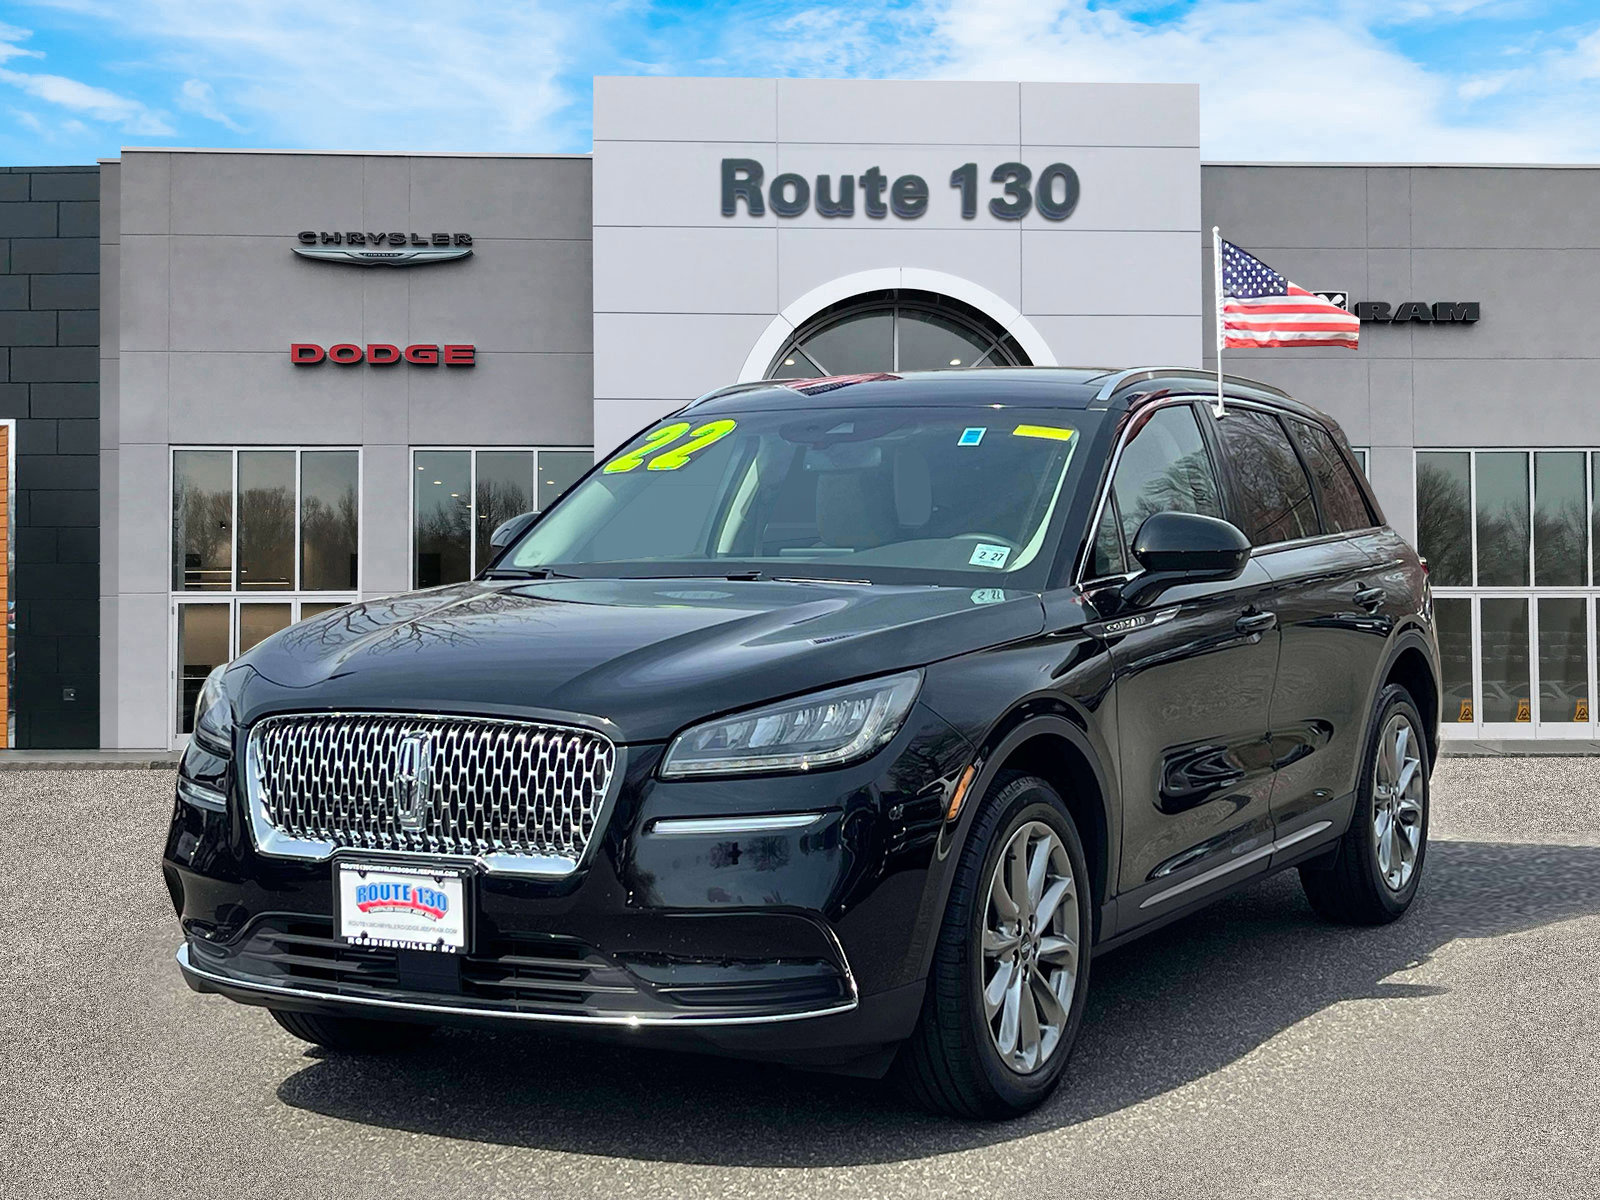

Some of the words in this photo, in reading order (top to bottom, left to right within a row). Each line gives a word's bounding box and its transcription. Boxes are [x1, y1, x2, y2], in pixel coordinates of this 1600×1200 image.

[721, 158, 930, 219] Route
[949, 162, 1081, 220] 130
[298, 231, 473, 245] CHRYSLER
[1354, 301, 1481, 325] RAM
[291, 343, 476, 366] DODGE
[603, 419, 738, 475] 22
[978, 551, 987, 560] 2
[991, 552, 1005, 562] 27
[356, 882, 412, 903] ROUTE
[417, 886, 449, 912] 130
[441, 944, 457, 954] NJ
